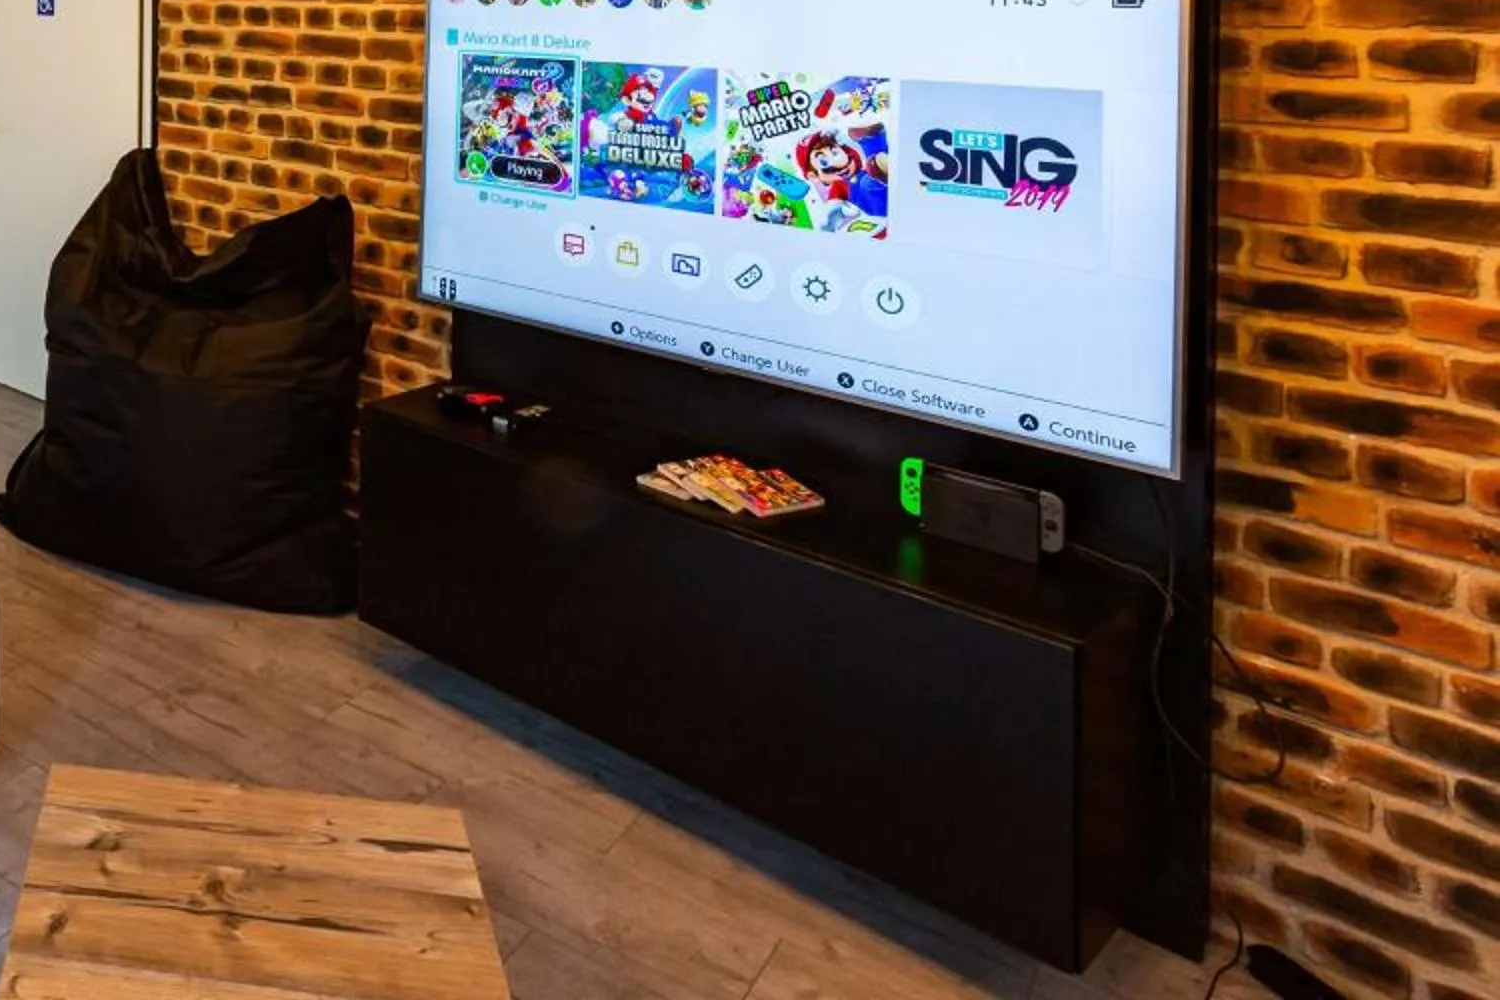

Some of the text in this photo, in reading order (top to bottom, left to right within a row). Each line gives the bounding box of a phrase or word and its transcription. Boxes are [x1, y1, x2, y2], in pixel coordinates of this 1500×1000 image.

[463, 31, 499, 46] Mario
[501, 33, 527, 47] Kart
[543, 34, 591, 49] Deluxe
[746, 81, 791, 105] SUPER
[740, 89, 811, 126] MARIO
[752, 110, 811, 141] PARTY
[959, 134, 997, 148] LET'S
[608, 146, 683, 169] DELUXE
[507, 162, 543, 179] Playing
[629, 325, 678, 347] Options
[721, 347, 773, 369] Change
[777, 360, 811, 377] User
[861, 379, 907, 401] Close
[911, 389, 986, 418] Software
[1049, 421, 1137, 453] Continue
